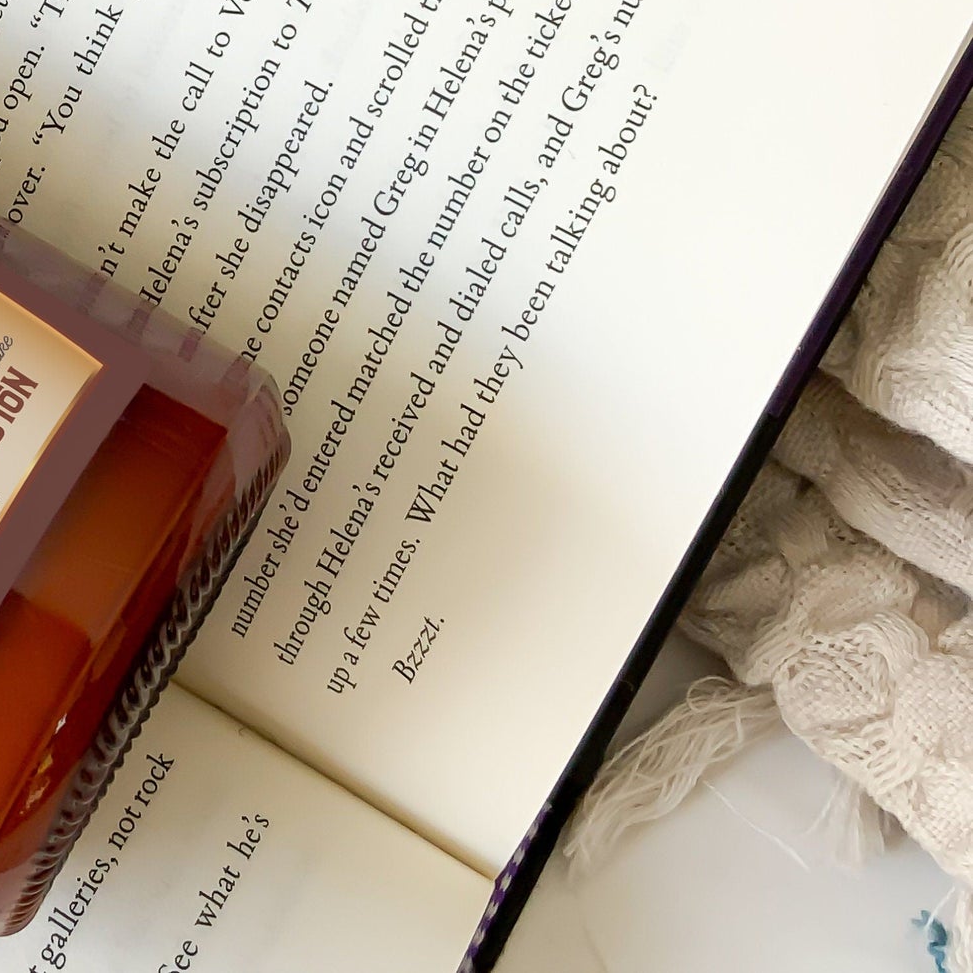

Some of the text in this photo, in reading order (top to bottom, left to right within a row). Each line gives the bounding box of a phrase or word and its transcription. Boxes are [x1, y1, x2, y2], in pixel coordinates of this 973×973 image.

[1, 166, 46, 226] over.
[30, 85, 84, 146] “You
[72, 3, 124, 76] think
[483, 109, 512, 144] on
[497, 62, 536, 105] the
[426, 144, 491, 251] number
[398, 251, 436, 294] the
[346, 290, 413, 405] matched
[301, 398, 357, 494] entered
[265, 488, 311, 555] she’d
[229, 551, 281, 639] number
[390, 615, 445, 685] Bzzzt.
[40, 752, 176, 971] galleries, not rock
[193, 812, 270, 928] what he’s
